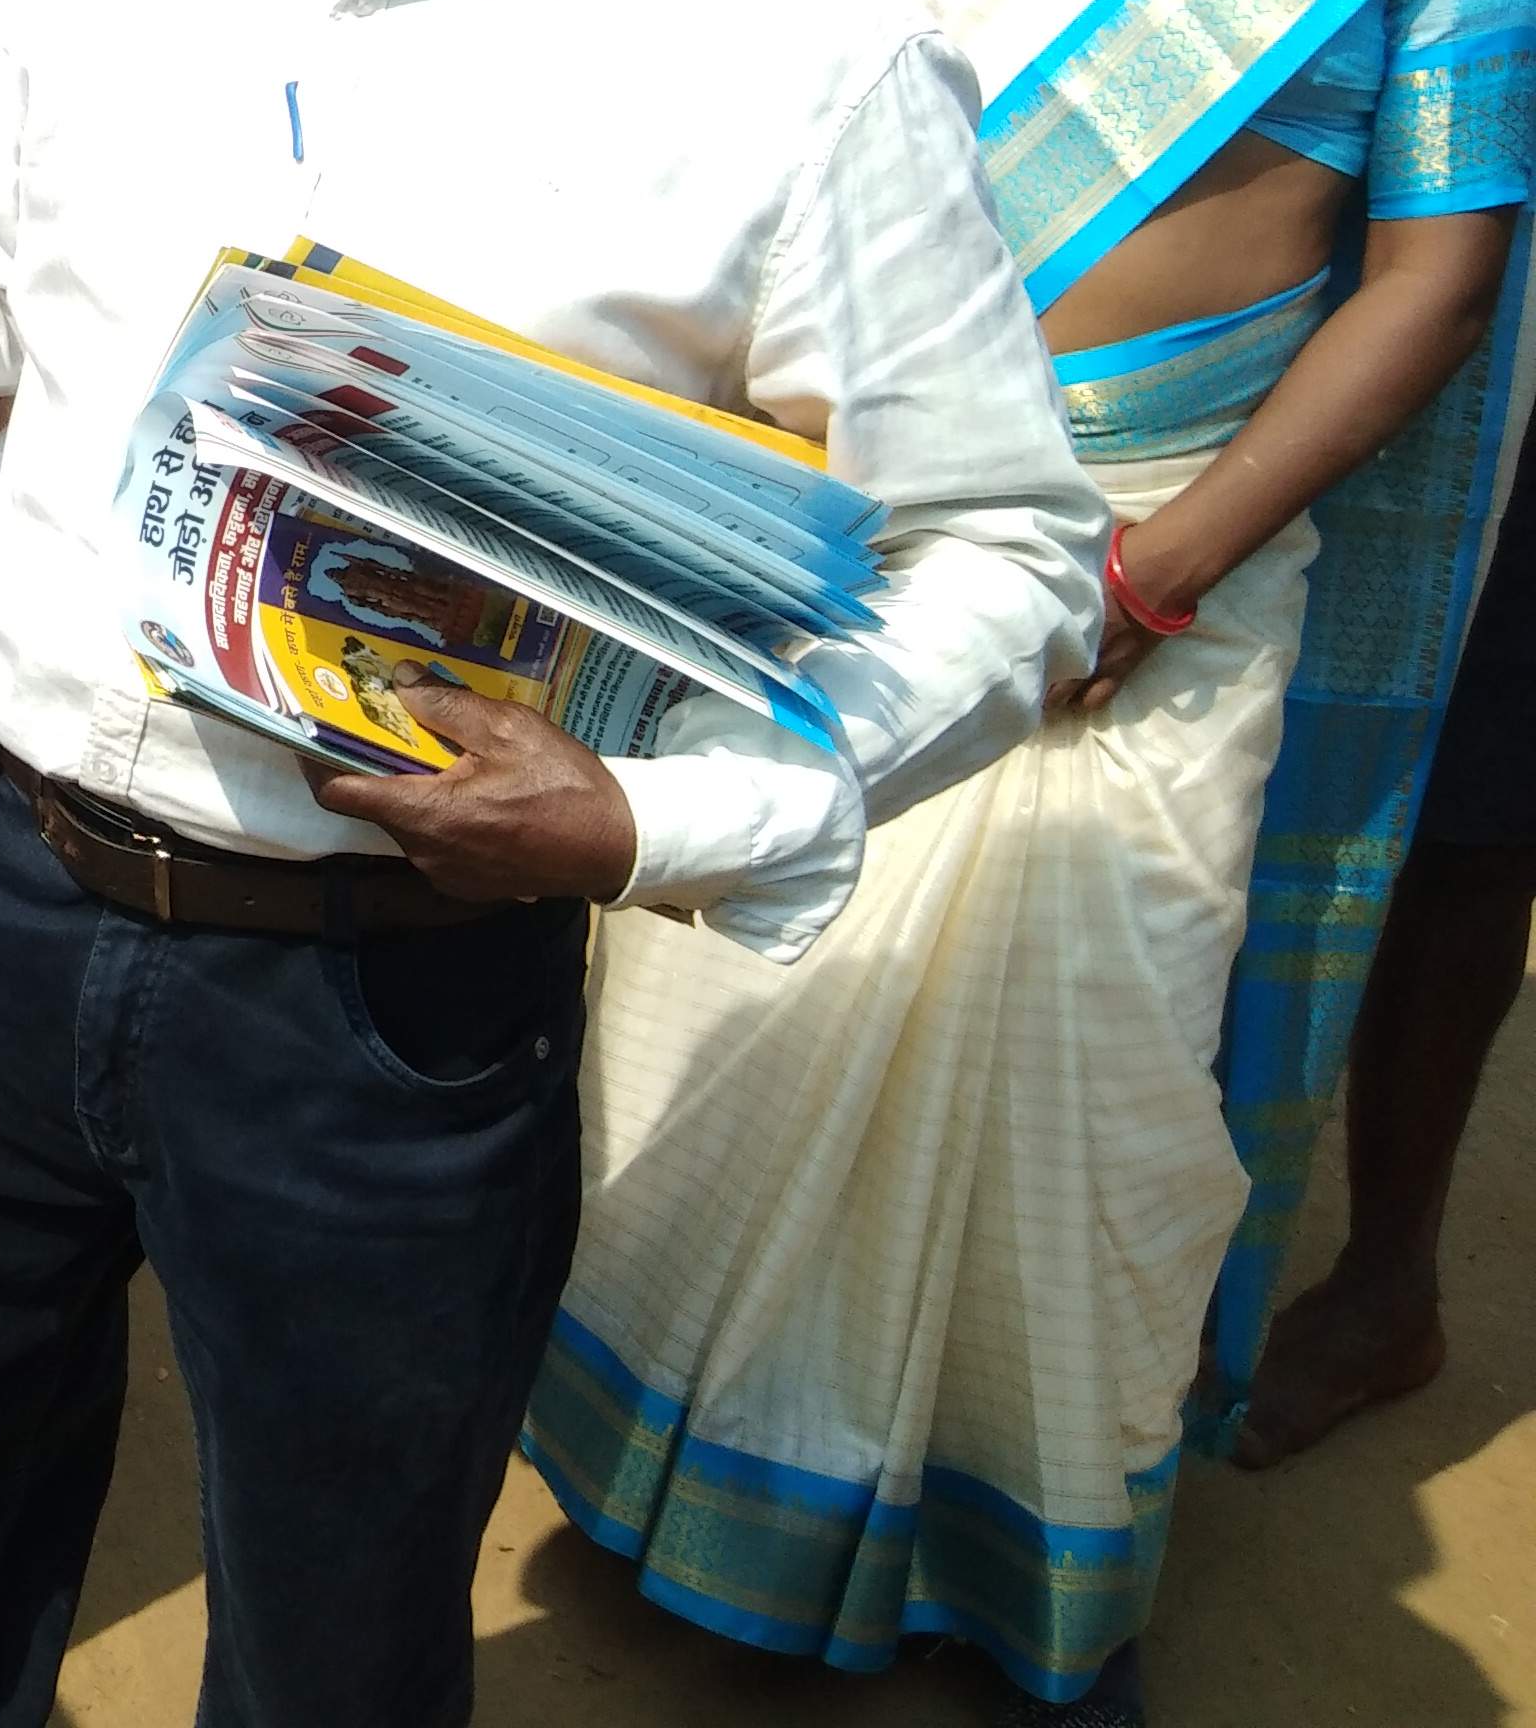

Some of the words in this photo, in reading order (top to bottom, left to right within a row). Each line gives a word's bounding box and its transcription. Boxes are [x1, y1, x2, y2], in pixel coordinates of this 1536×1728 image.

[152, 445, 185, 477] से
[139, 480, 173, 547] हाथ
[168, 509, 208, 586] जोड़ो
[241, 519, 262, 566] और
